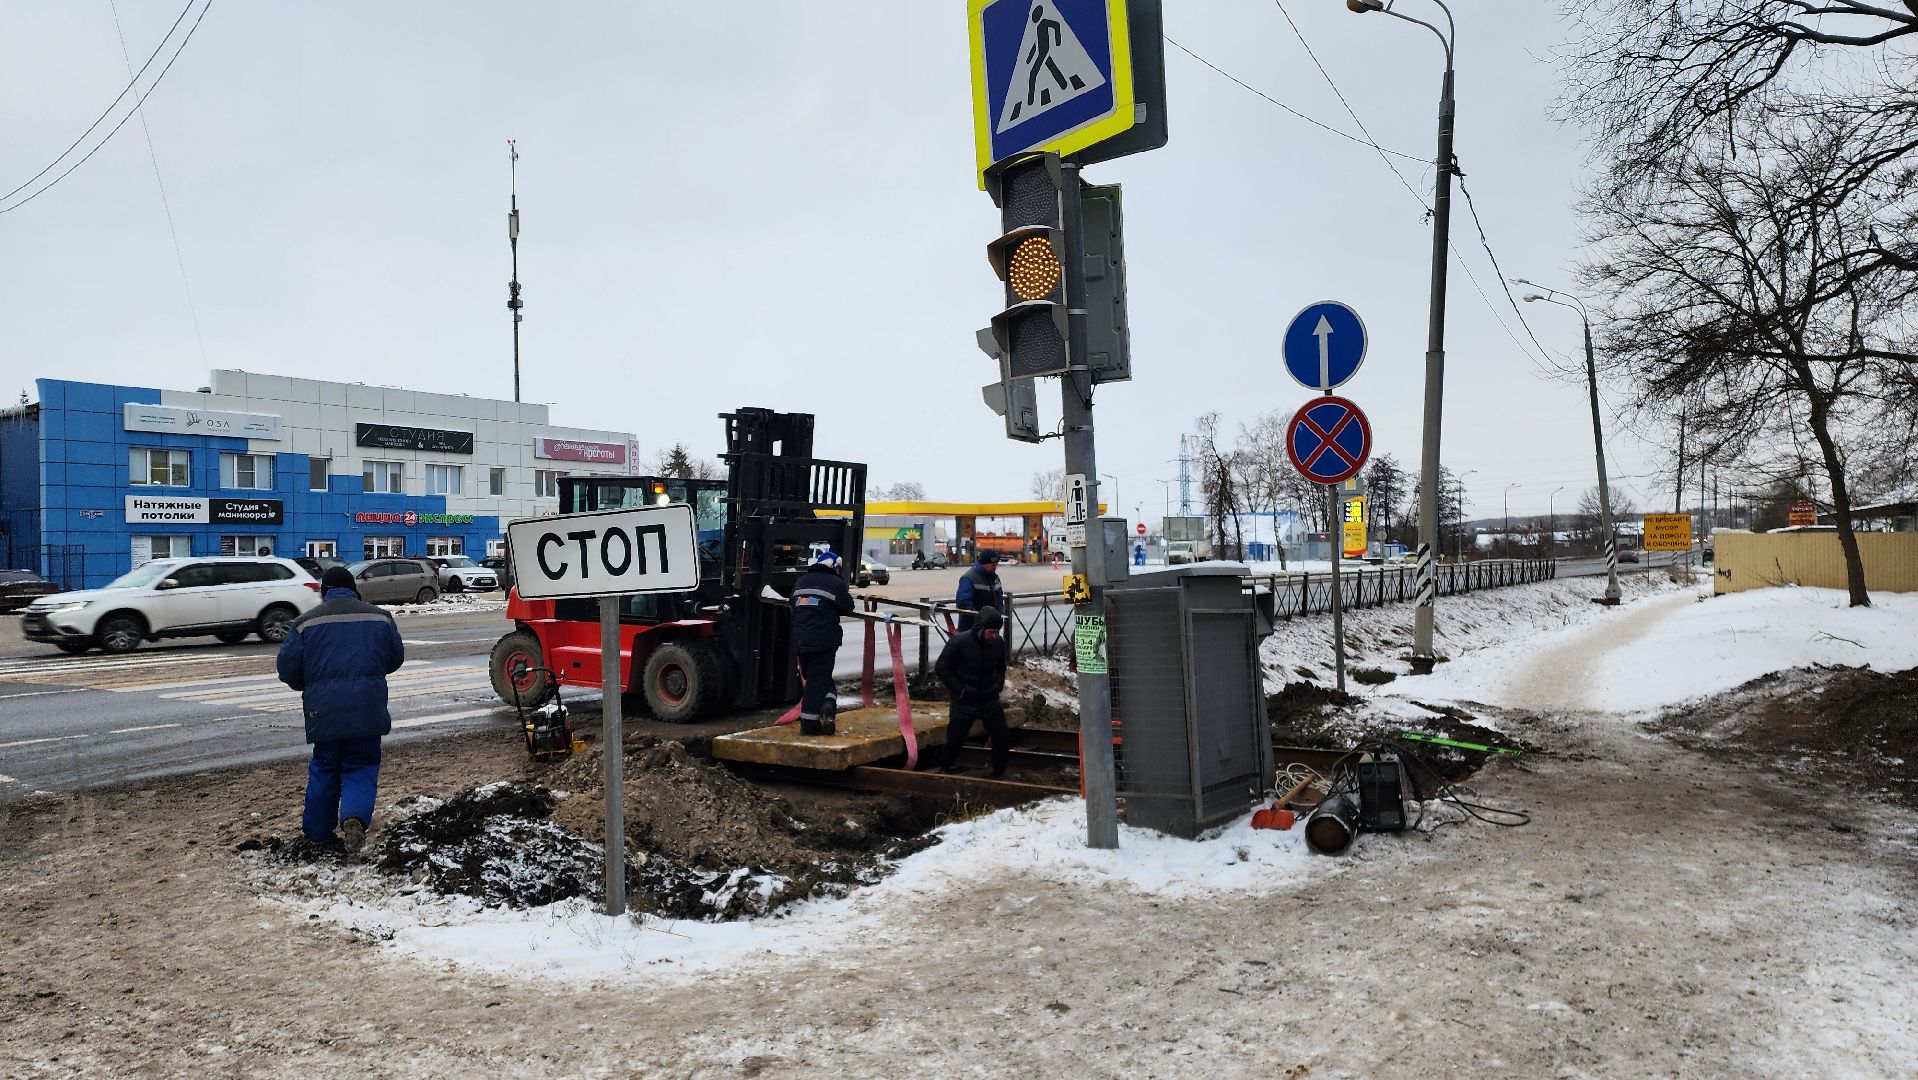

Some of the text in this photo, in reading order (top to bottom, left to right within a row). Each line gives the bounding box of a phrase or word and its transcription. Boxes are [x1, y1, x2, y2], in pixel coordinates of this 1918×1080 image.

[390, 427, 444, 441] СТУДИЯ
[133, 499, 202, 510] Натяжные
[225, 502, 259, 512] Студия
[141, 511, 195, 520] потолки
[217, 511, 267, 520] маникюра
[536, 523, 669, 581] СТОП
